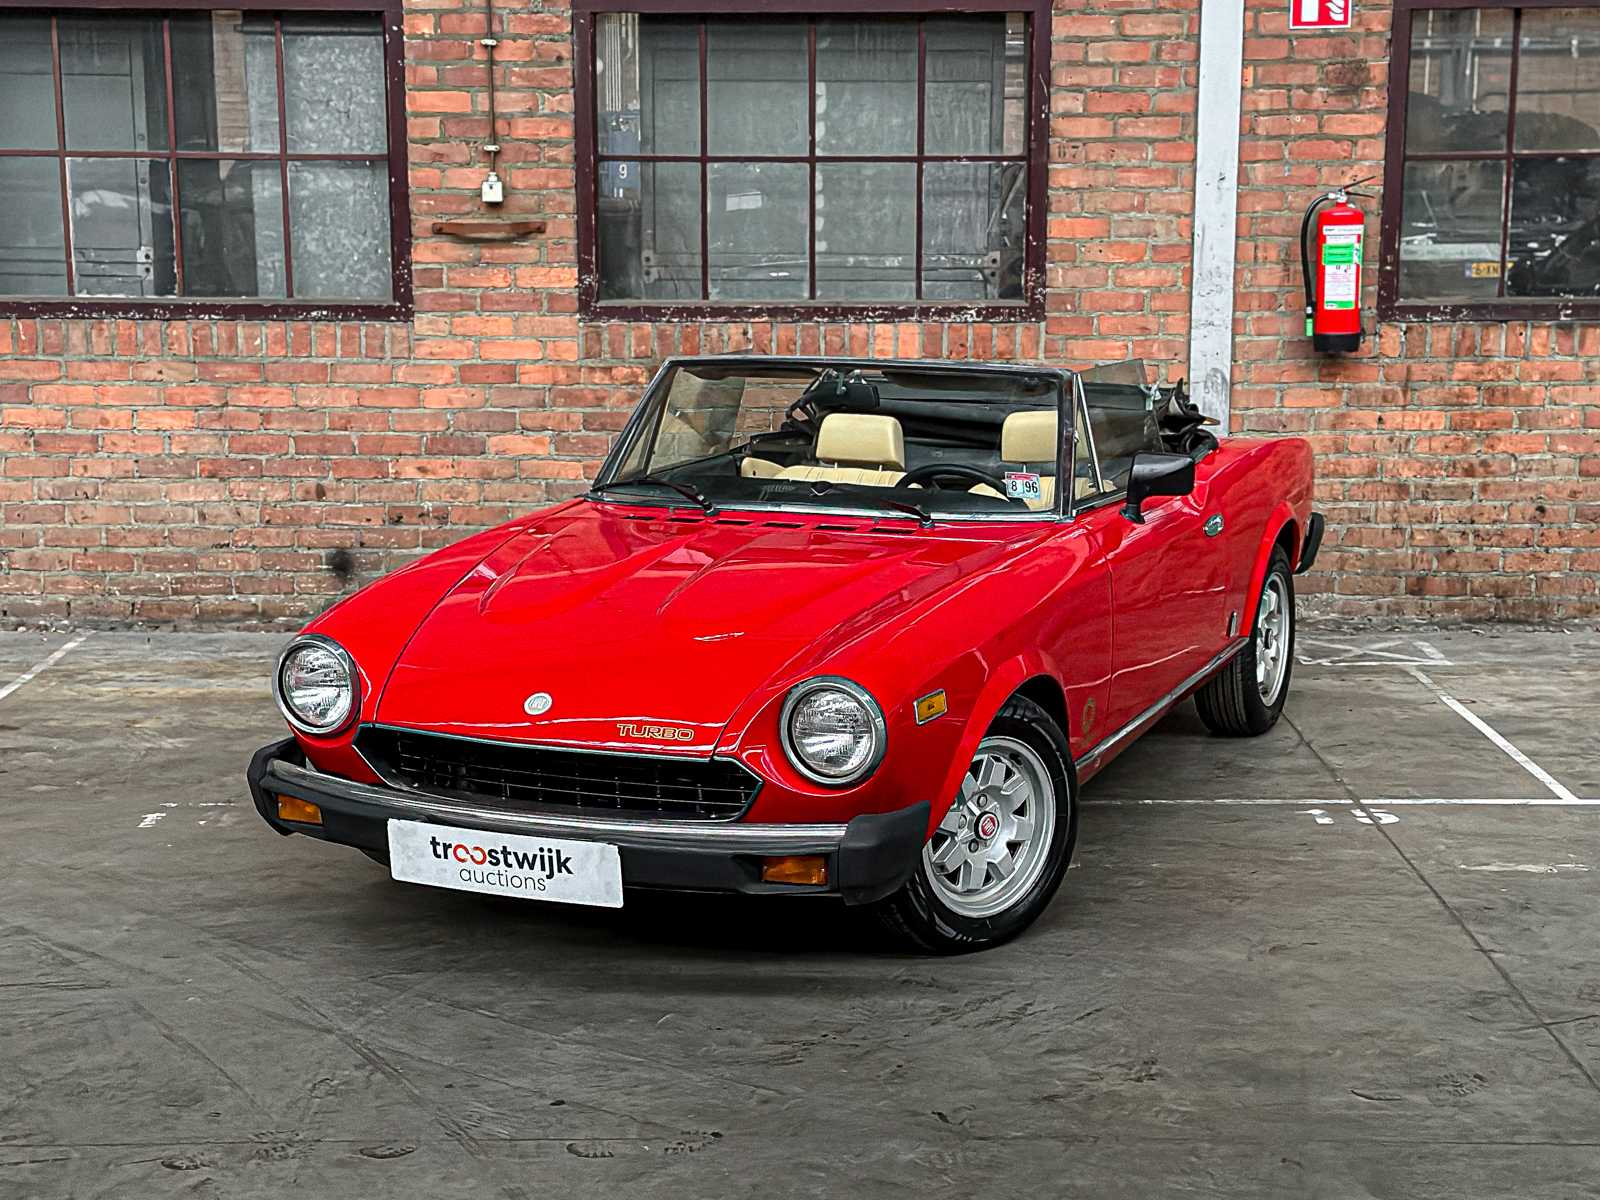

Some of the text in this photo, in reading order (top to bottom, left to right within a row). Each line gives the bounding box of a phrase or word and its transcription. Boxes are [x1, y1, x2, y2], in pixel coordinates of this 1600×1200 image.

[619, 163, 628, 179] 9
[1011, 480, 1038, 494] 8 96
[616, 723, 695, 742] TURBO
[429, 835, 575, 880] troostwijk
[458, 867, 547, 891] auctions
